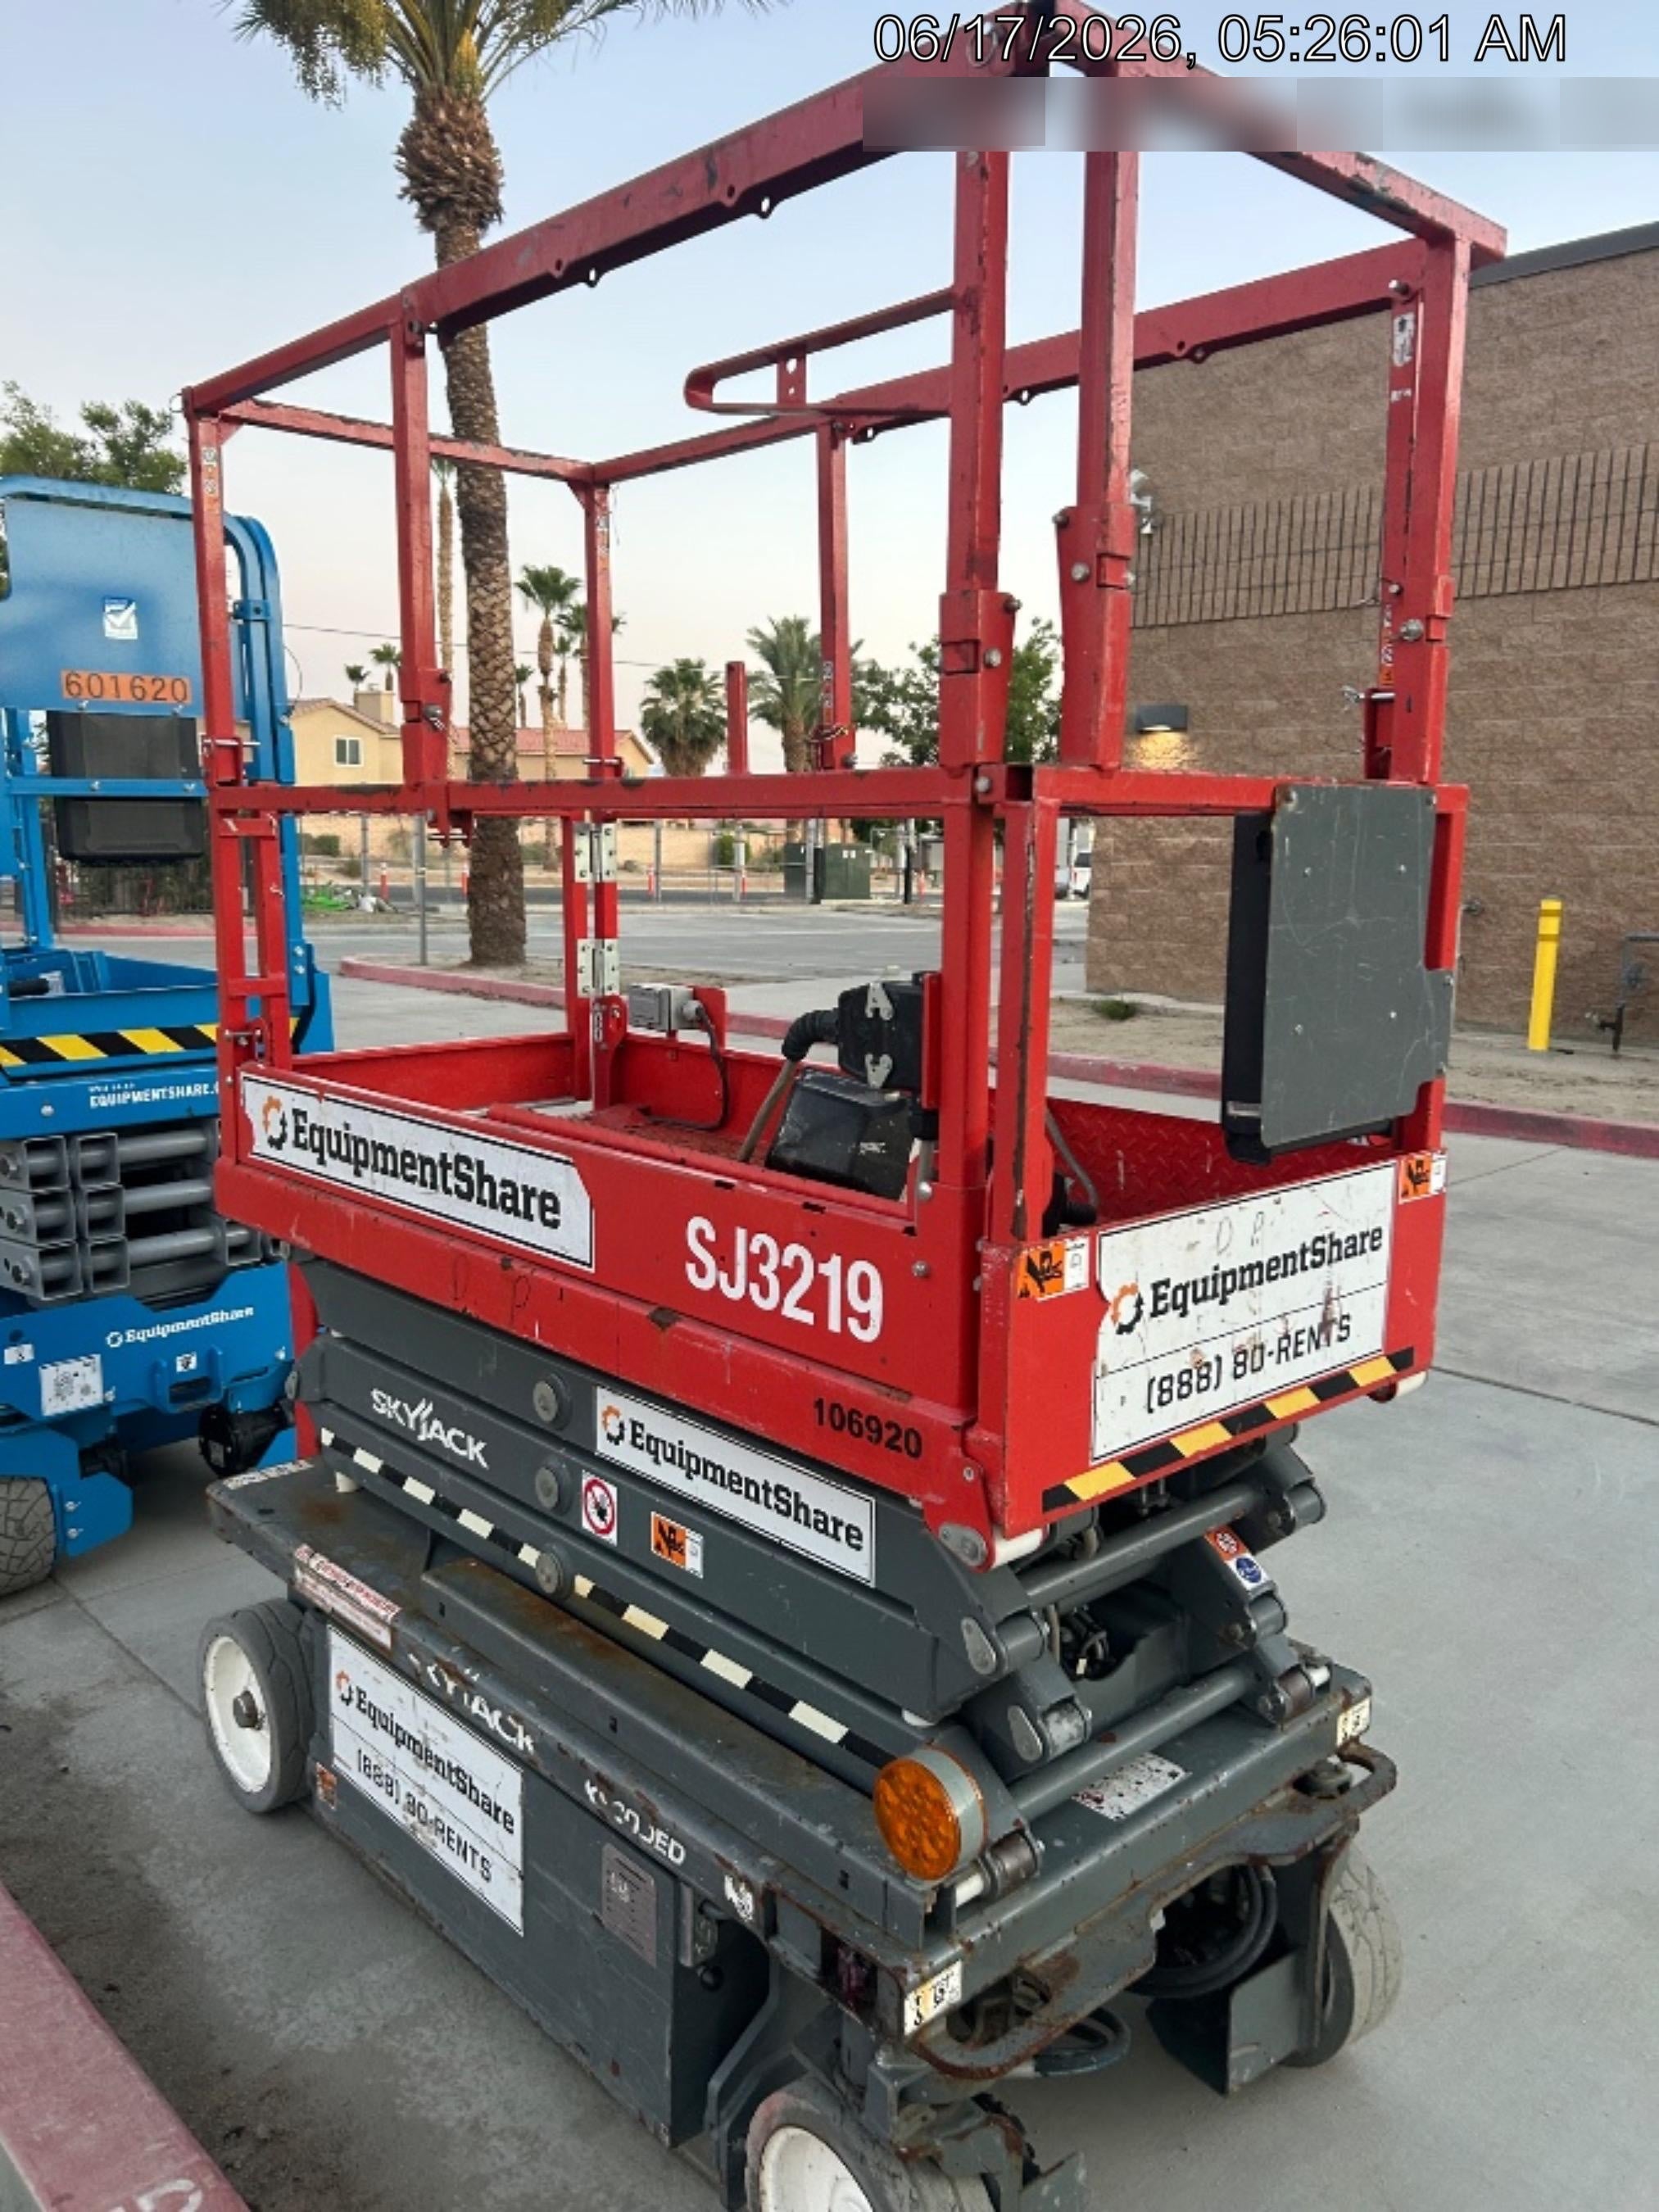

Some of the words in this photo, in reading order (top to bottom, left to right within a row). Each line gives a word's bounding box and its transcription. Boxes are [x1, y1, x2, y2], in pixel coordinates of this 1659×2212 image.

[65, 671, 188, 703] 601620
[291, 1108, 561, 1230] EquipmentShare
[685, 1216, 883, 1343] SJ3219
[1149, 1226, 1383, 1318] EquipmentShare
[370, 1388, 490, 1471] SKYJACK
[813, 1398, 923, 1459] 106920
[1146, 1353, 1222, 1414] (888)
[628, 1419, 864, 1552] EquipmentShare
[356, 1685, 514, 1835] EquipmentShare
